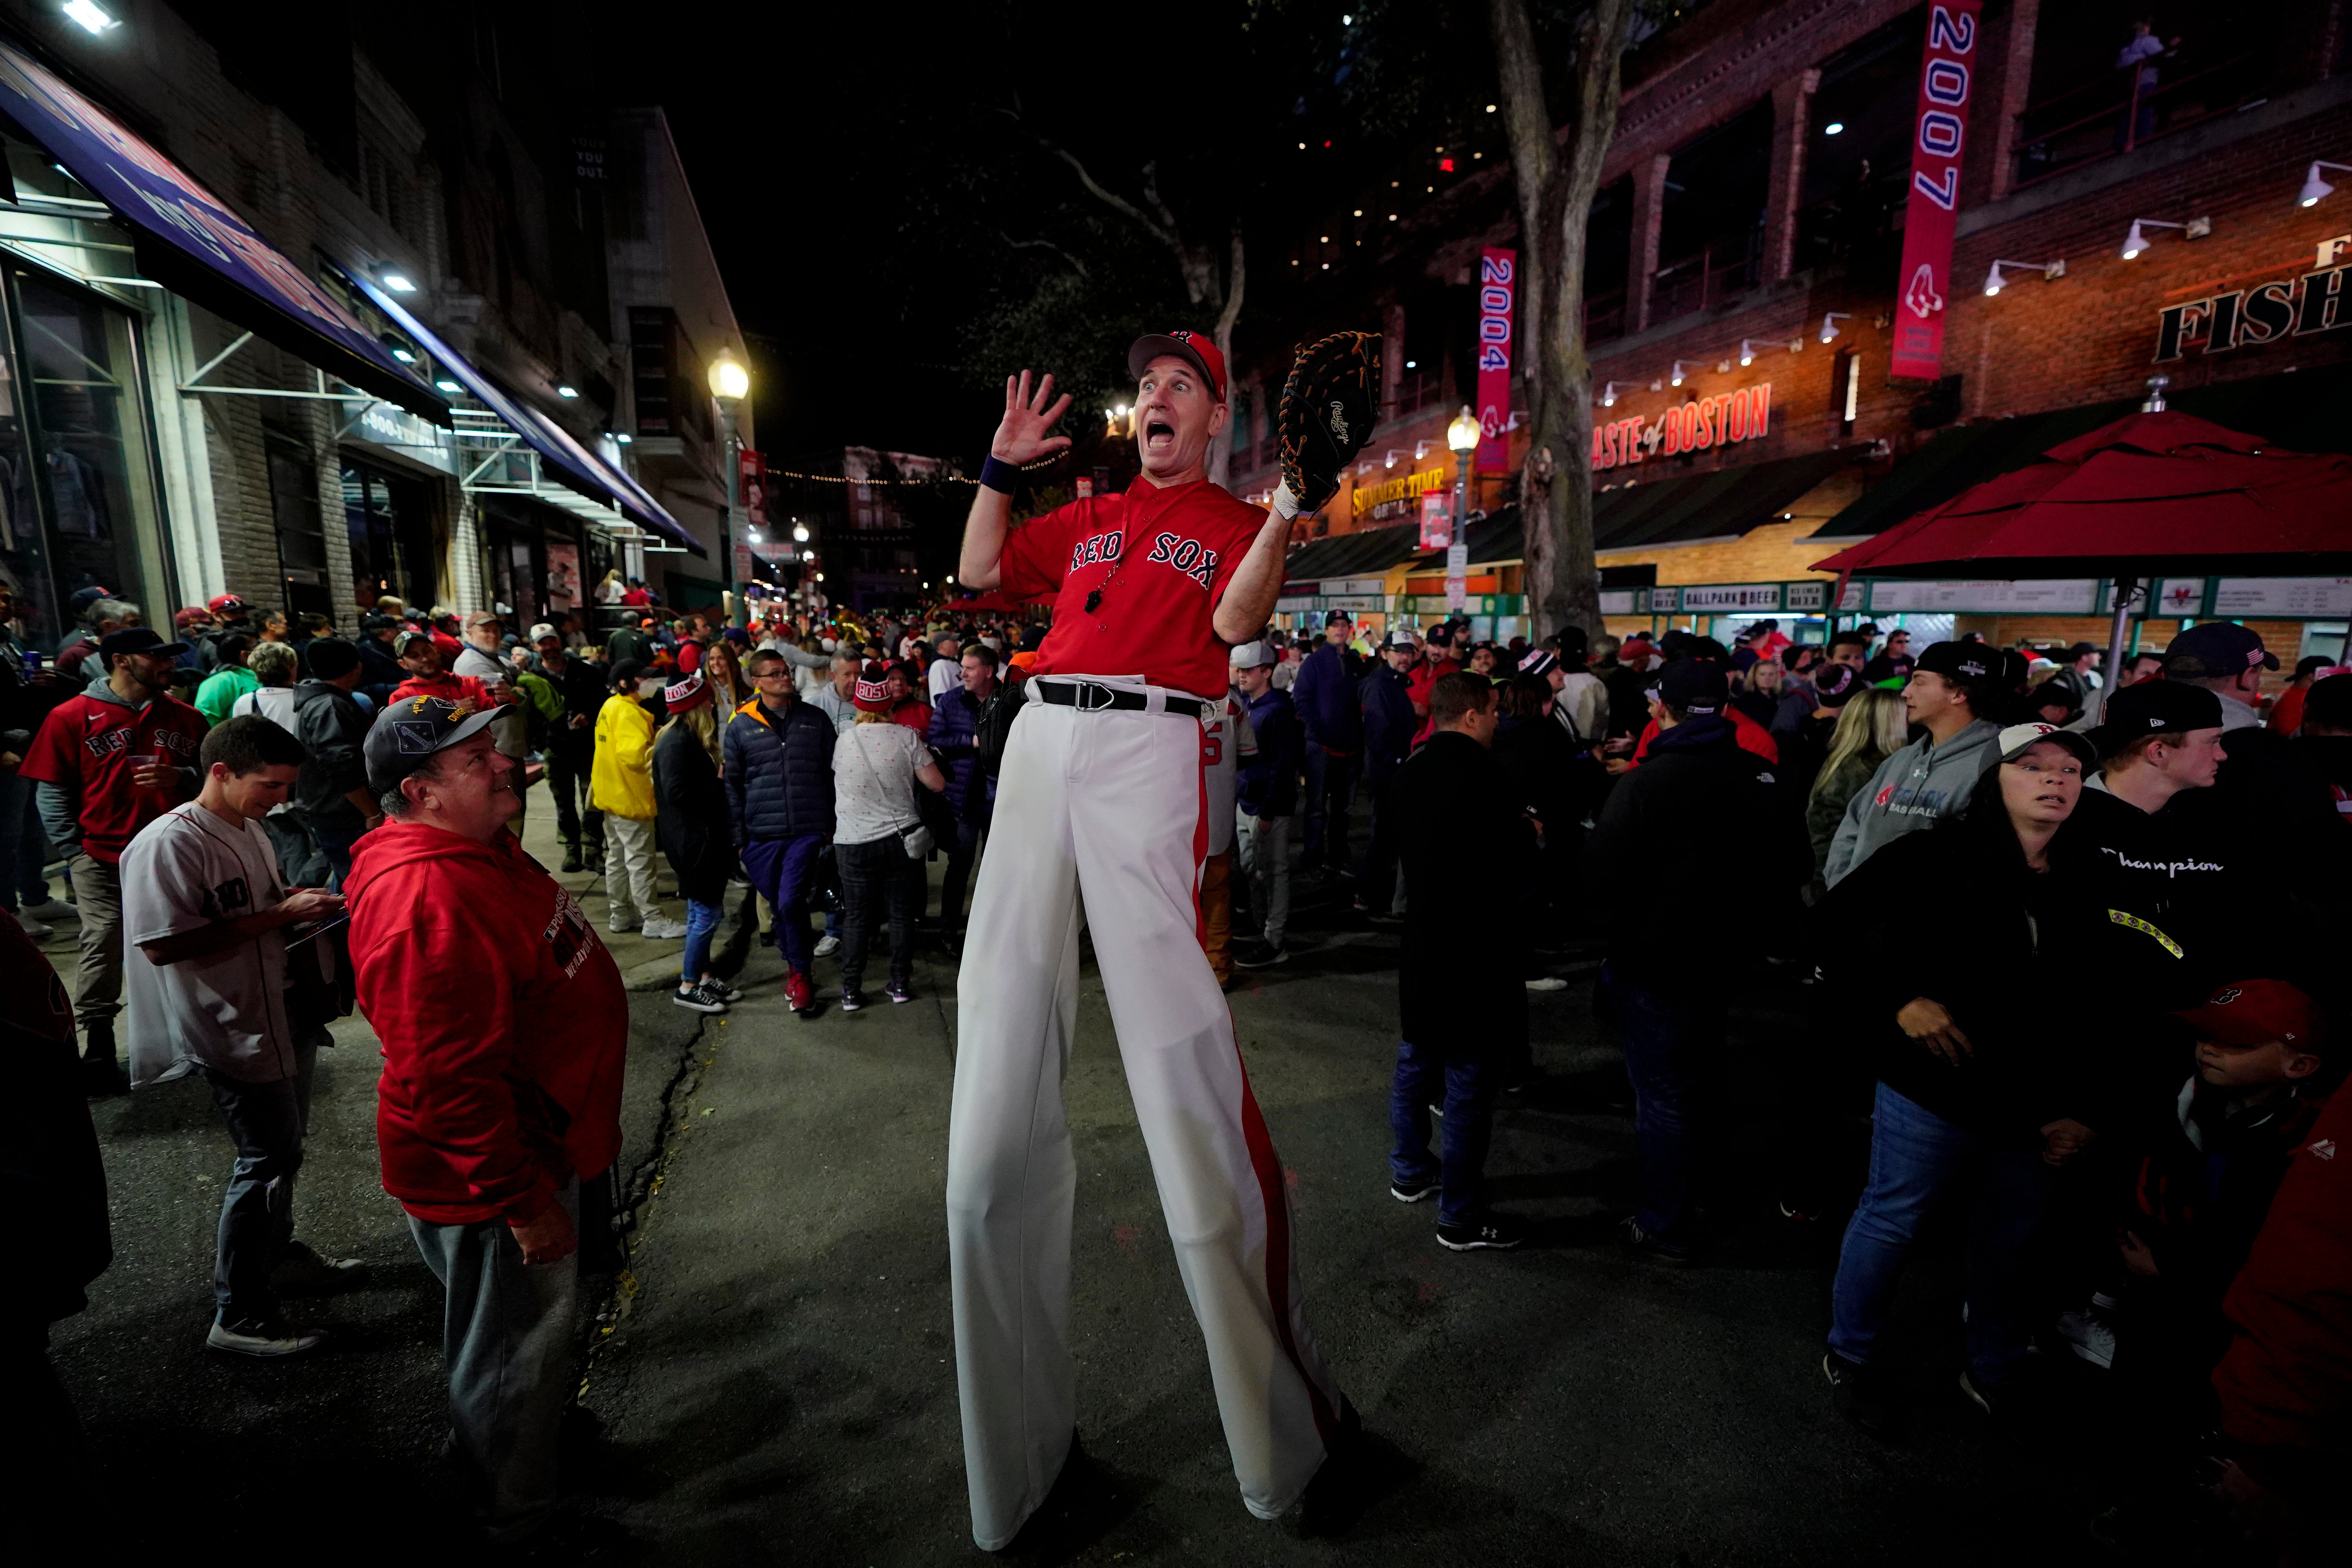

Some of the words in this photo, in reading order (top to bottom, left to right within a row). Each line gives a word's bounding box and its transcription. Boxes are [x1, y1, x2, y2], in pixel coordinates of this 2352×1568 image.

[1914, 5, 1975, 210] 2007
[1479, 256, 1512, 372] 2004
[2151, 263, 2352, 364] FISH
[1330, 401, 1349, 444] Rawlings
[1592, 415, 1645, 470] ASTE
[1642, 413, 1665, 456] of
[1664, 382, 1771, 457] BOSTON
[1069, 530, 1123, 577] RED
[1147, 532, 1218, 591] SOX
[1686, 591, 1737, 605] BALLPARK
[1749, 590, 1778, 604] BEER
[858, 683, 888, 698] BOST
[85, 728, 134, 757] RED
[154, 729, 196, 757] SOX
